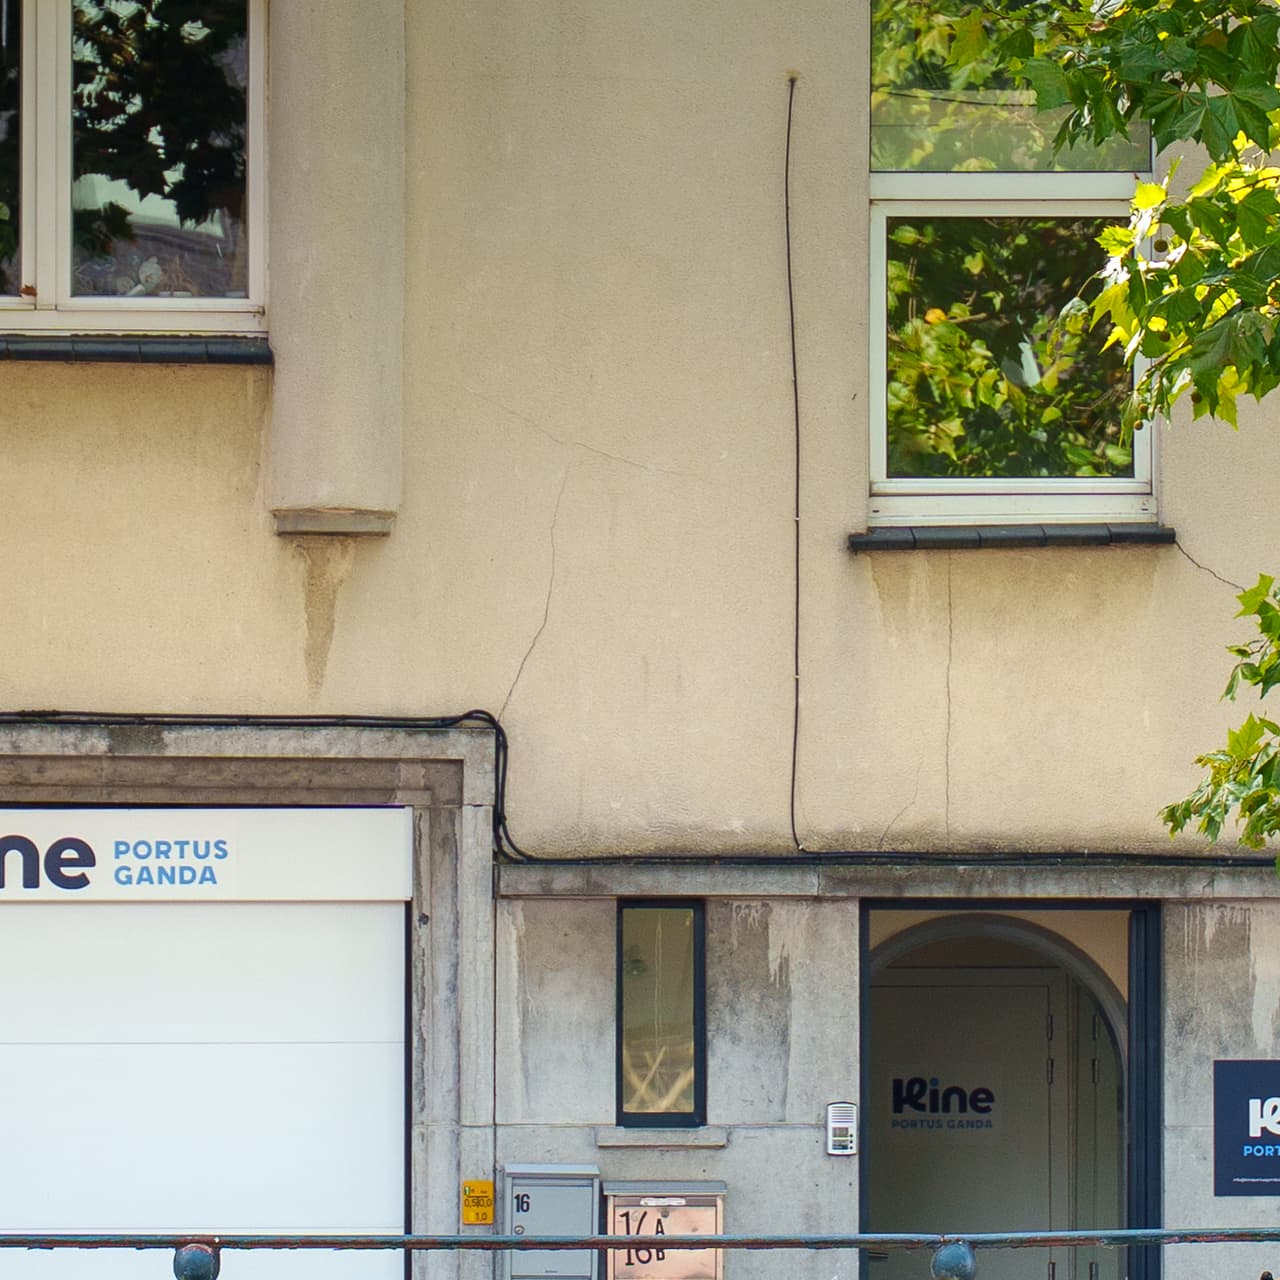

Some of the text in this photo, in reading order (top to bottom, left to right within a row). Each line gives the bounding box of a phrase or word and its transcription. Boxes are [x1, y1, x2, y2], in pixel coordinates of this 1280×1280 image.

[113, 839, 229, 860] PORTUS
[113, 865, 218, 886] GANDA
[892, 1077, 995, 1114] Kine
[891, 1119, 993, 1129] PORTUS GANDA
[514, 1193, 530, 1213] 16
